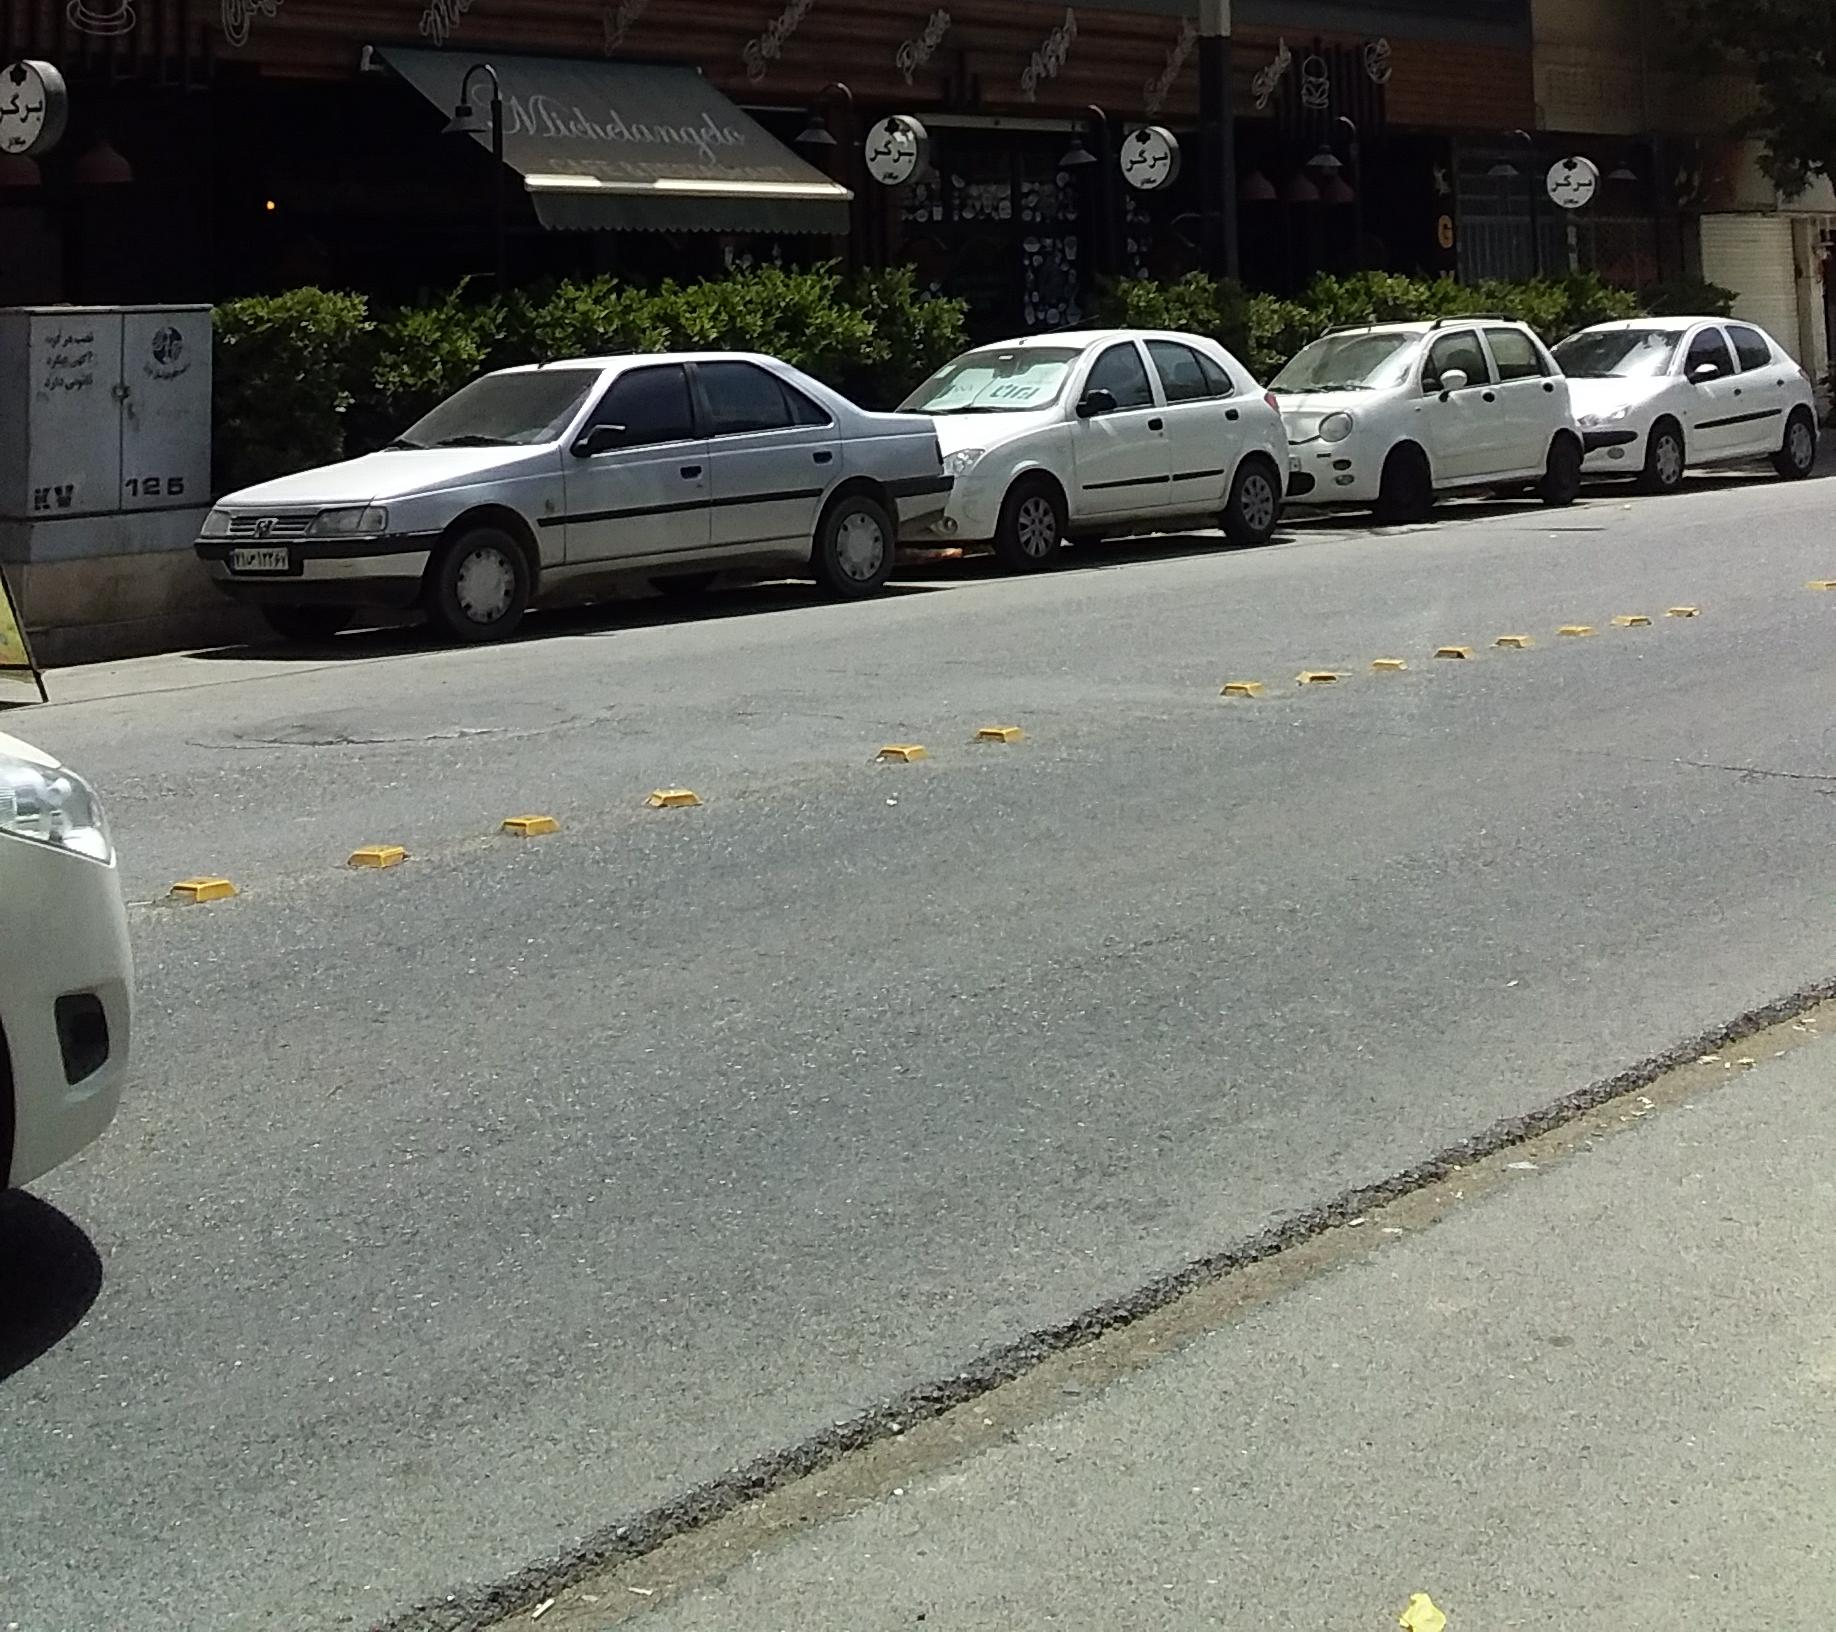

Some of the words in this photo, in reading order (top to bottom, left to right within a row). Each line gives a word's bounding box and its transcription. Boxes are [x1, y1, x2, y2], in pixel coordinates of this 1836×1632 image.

[470, 84, 747, 164] Michelangelo
[869, 139, 915, 164] برگر
[1125, 148, 1169, 173] برگر
[1551, 174, 1592, 192] برگر
